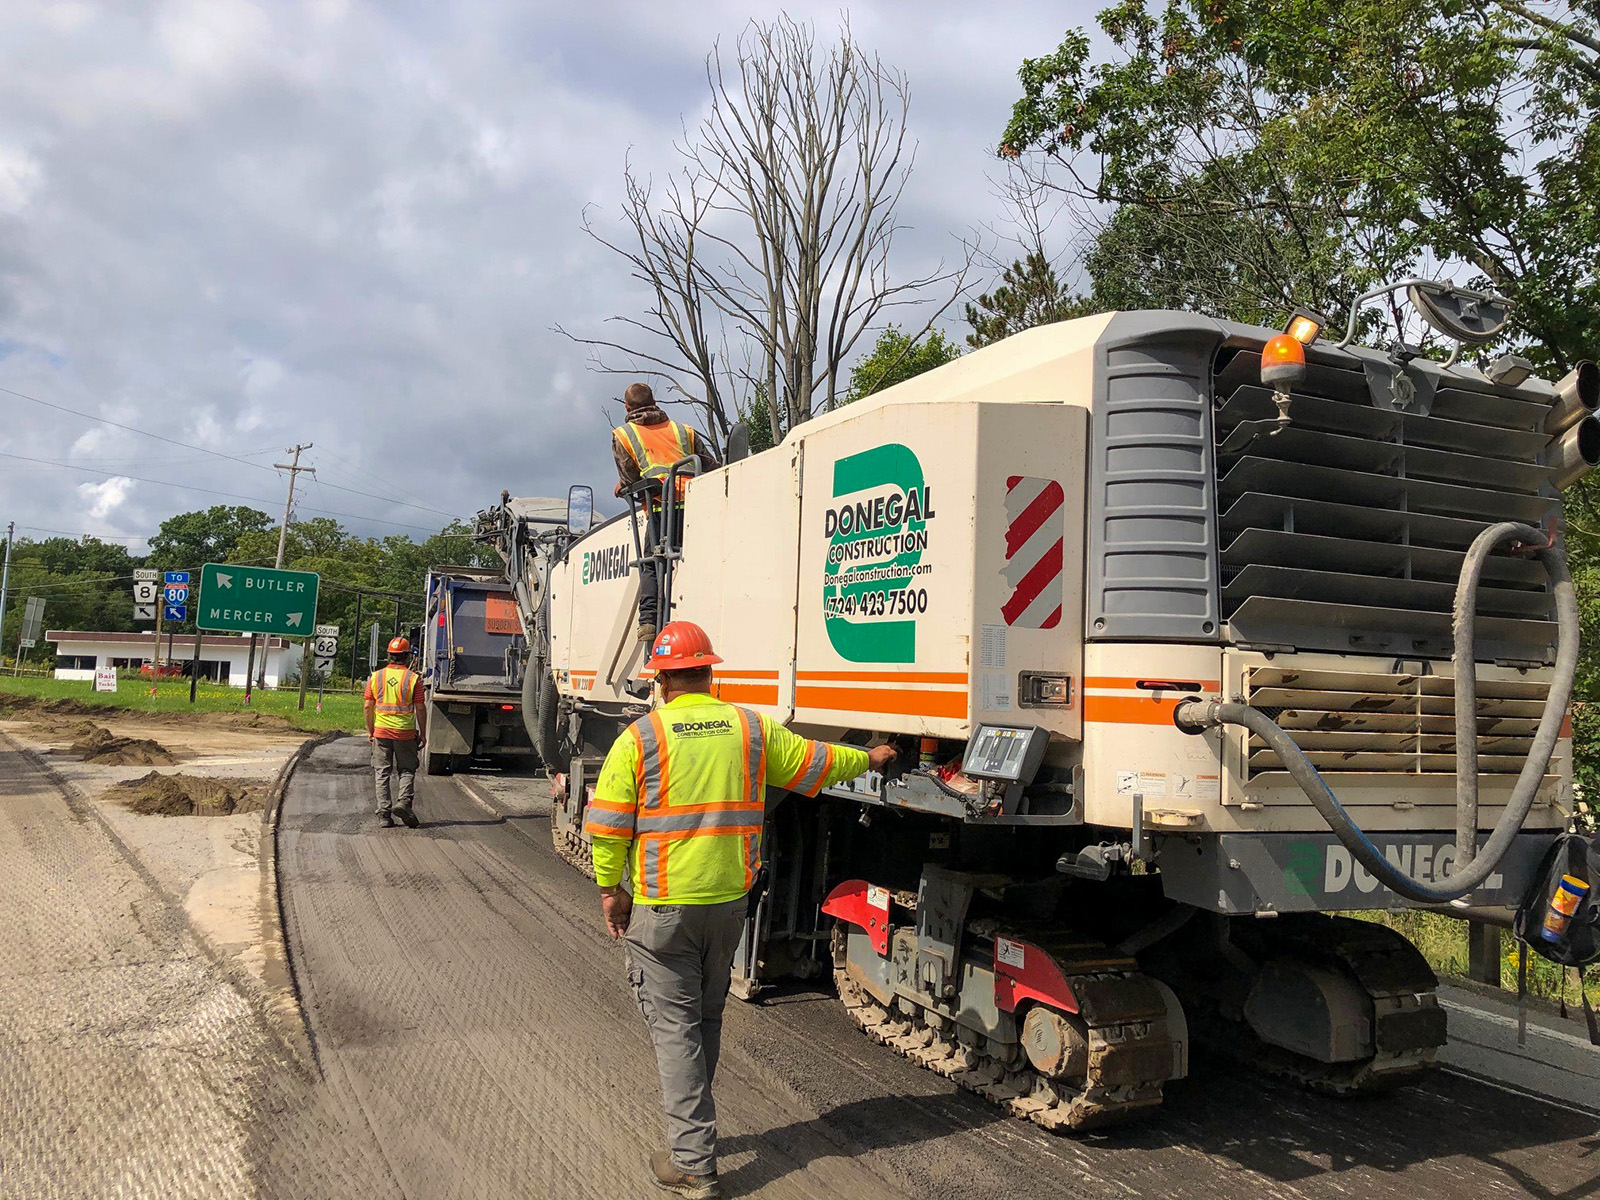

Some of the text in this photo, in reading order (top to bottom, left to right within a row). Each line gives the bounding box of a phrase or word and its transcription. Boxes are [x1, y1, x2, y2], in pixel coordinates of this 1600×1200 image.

[825, 486, 935, 538] DONEGAL
[828, 531, 928, 564] CONSTRUCTION
[589, 543, 630, 583] DONEGAL
[135, 571, 157, 579] SOUTH
[824, 564, 932, 587] Donegalconstruction.com
[140, 586, 151, 599] 8
[245, 577, 305, 593] BUTLER
[168, 589, 185, 602] 80
[826, 588, 928, 618] (724) 423 7500
[210, 608, 273, 623] MERCER
[317, 626, 338, 635] SOUTH
[318, 641, 334, 653] 62
[684, 720, 732, 731] DONEGAL
[1325, 844, 1503, 893] DONEG
